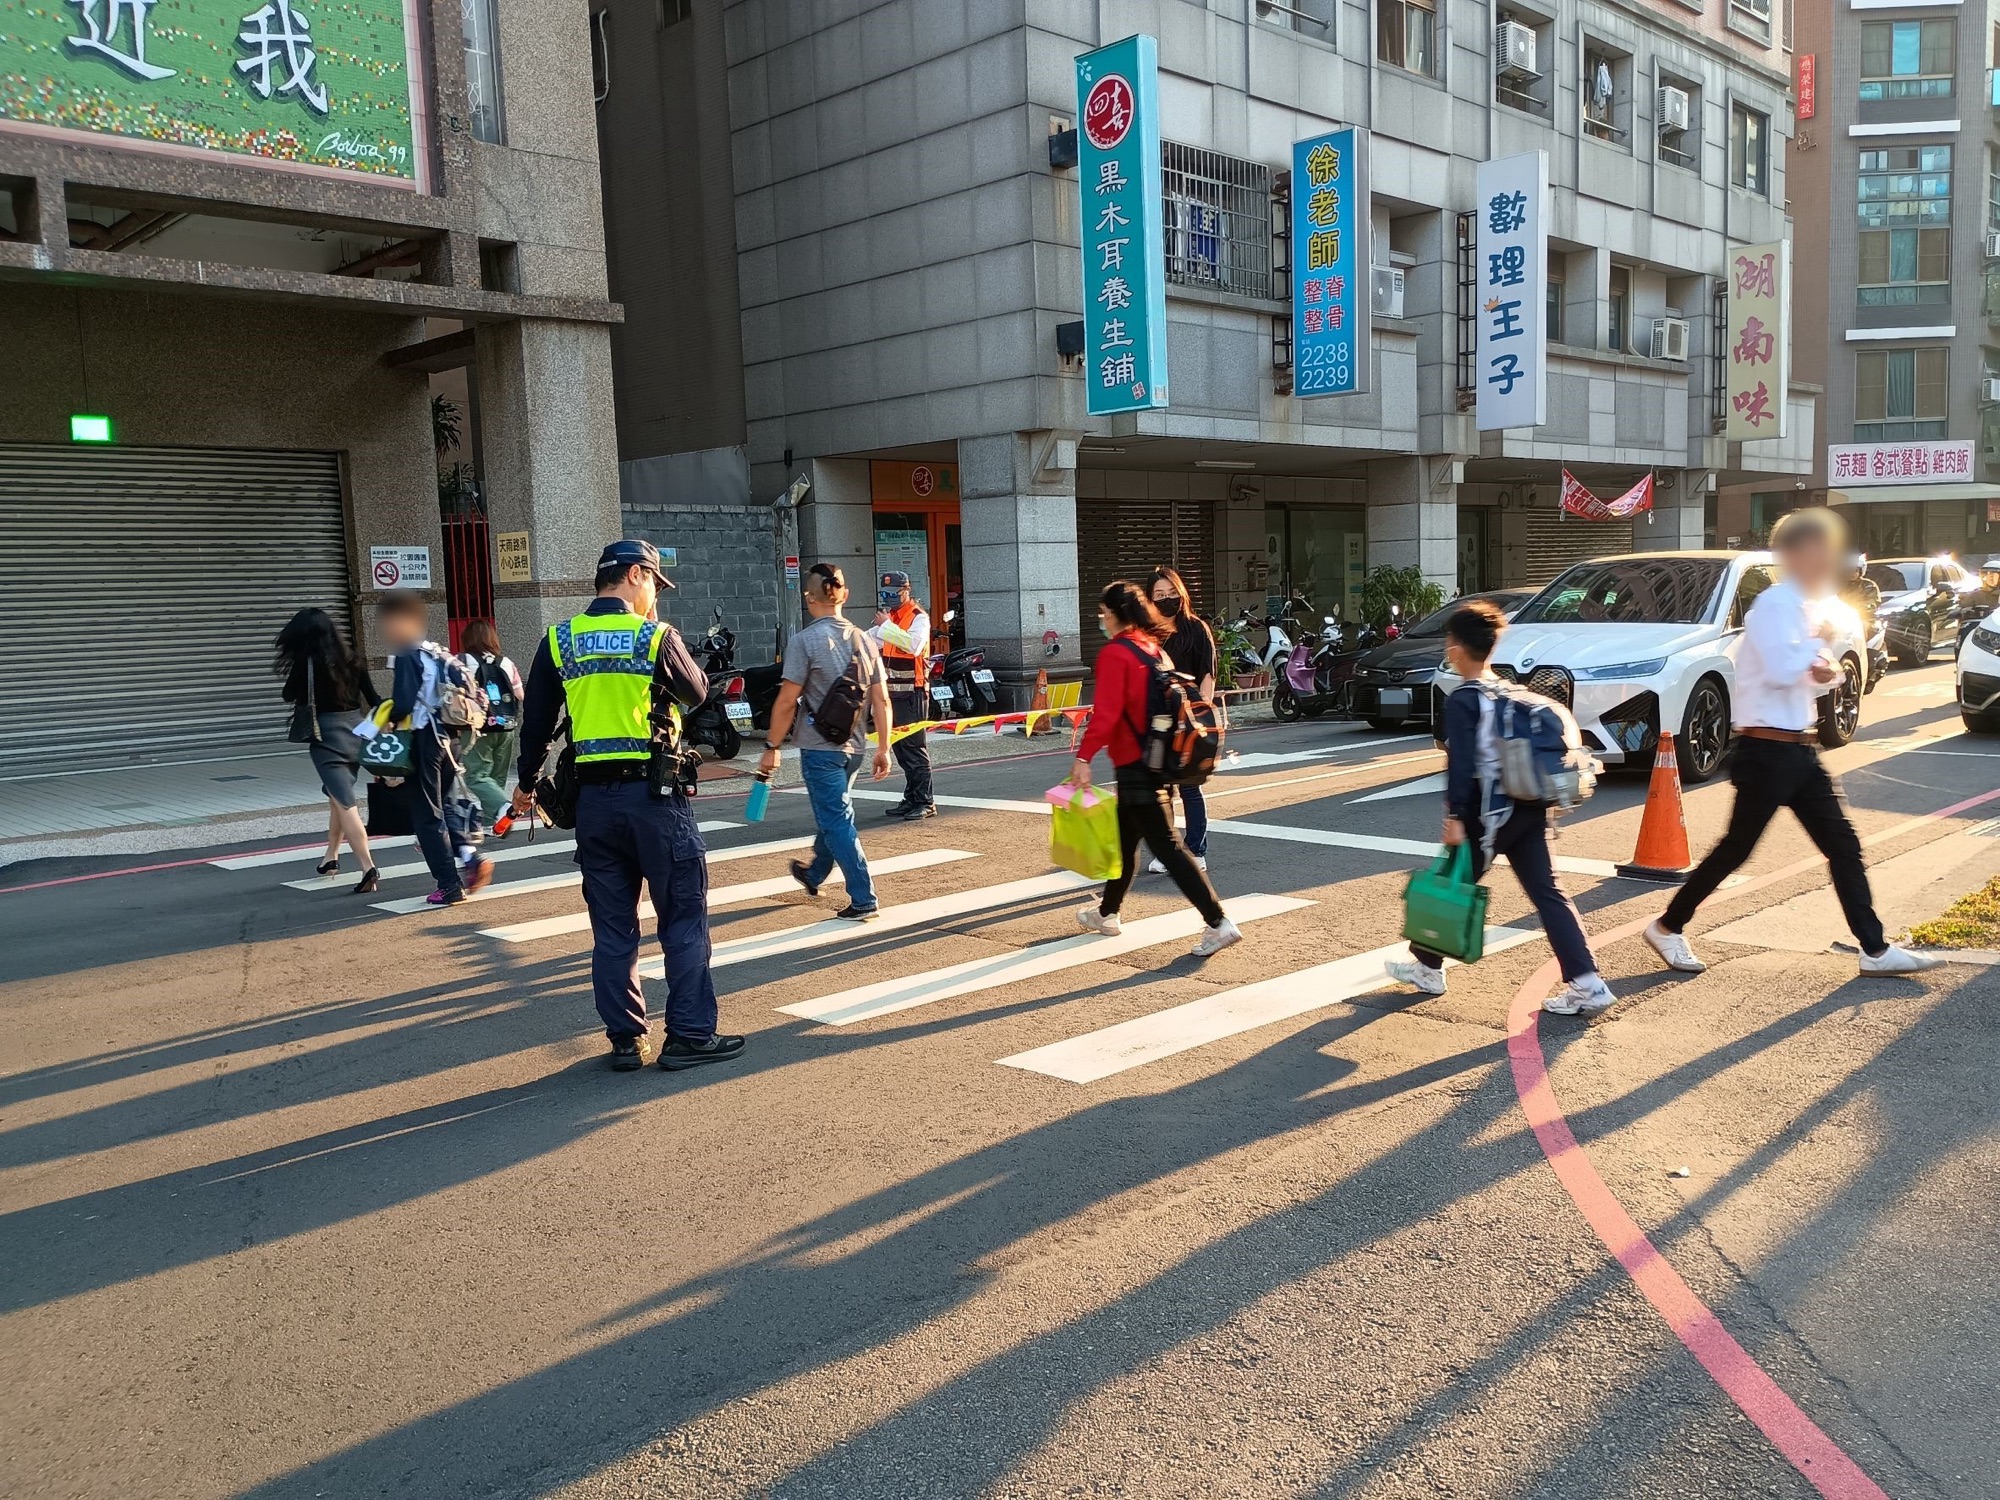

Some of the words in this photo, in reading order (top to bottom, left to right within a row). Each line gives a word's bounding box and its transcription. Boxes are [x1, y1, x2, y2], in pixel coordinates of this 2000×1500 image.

[1306, 142, 1341, 272] 徐老師
[1488, 190, 1528, 396] 數理王子
[1732, 253, 1775, 428] 湖南味
[1301, 342, 1349, 367] 2238
[1301, 365, 1349, 390] 2239
[1835, 452, 1868, 477] 涼麵
[1872, 446, 1930, 479] 各式餐點
[1932, 449, 1969, 475] 雞肉飯
[499, 537, 527, 552] 天雨路滑
[500, 555, 529, 570] 小心跌倒
[577, 634, 631, 654] POLICE
